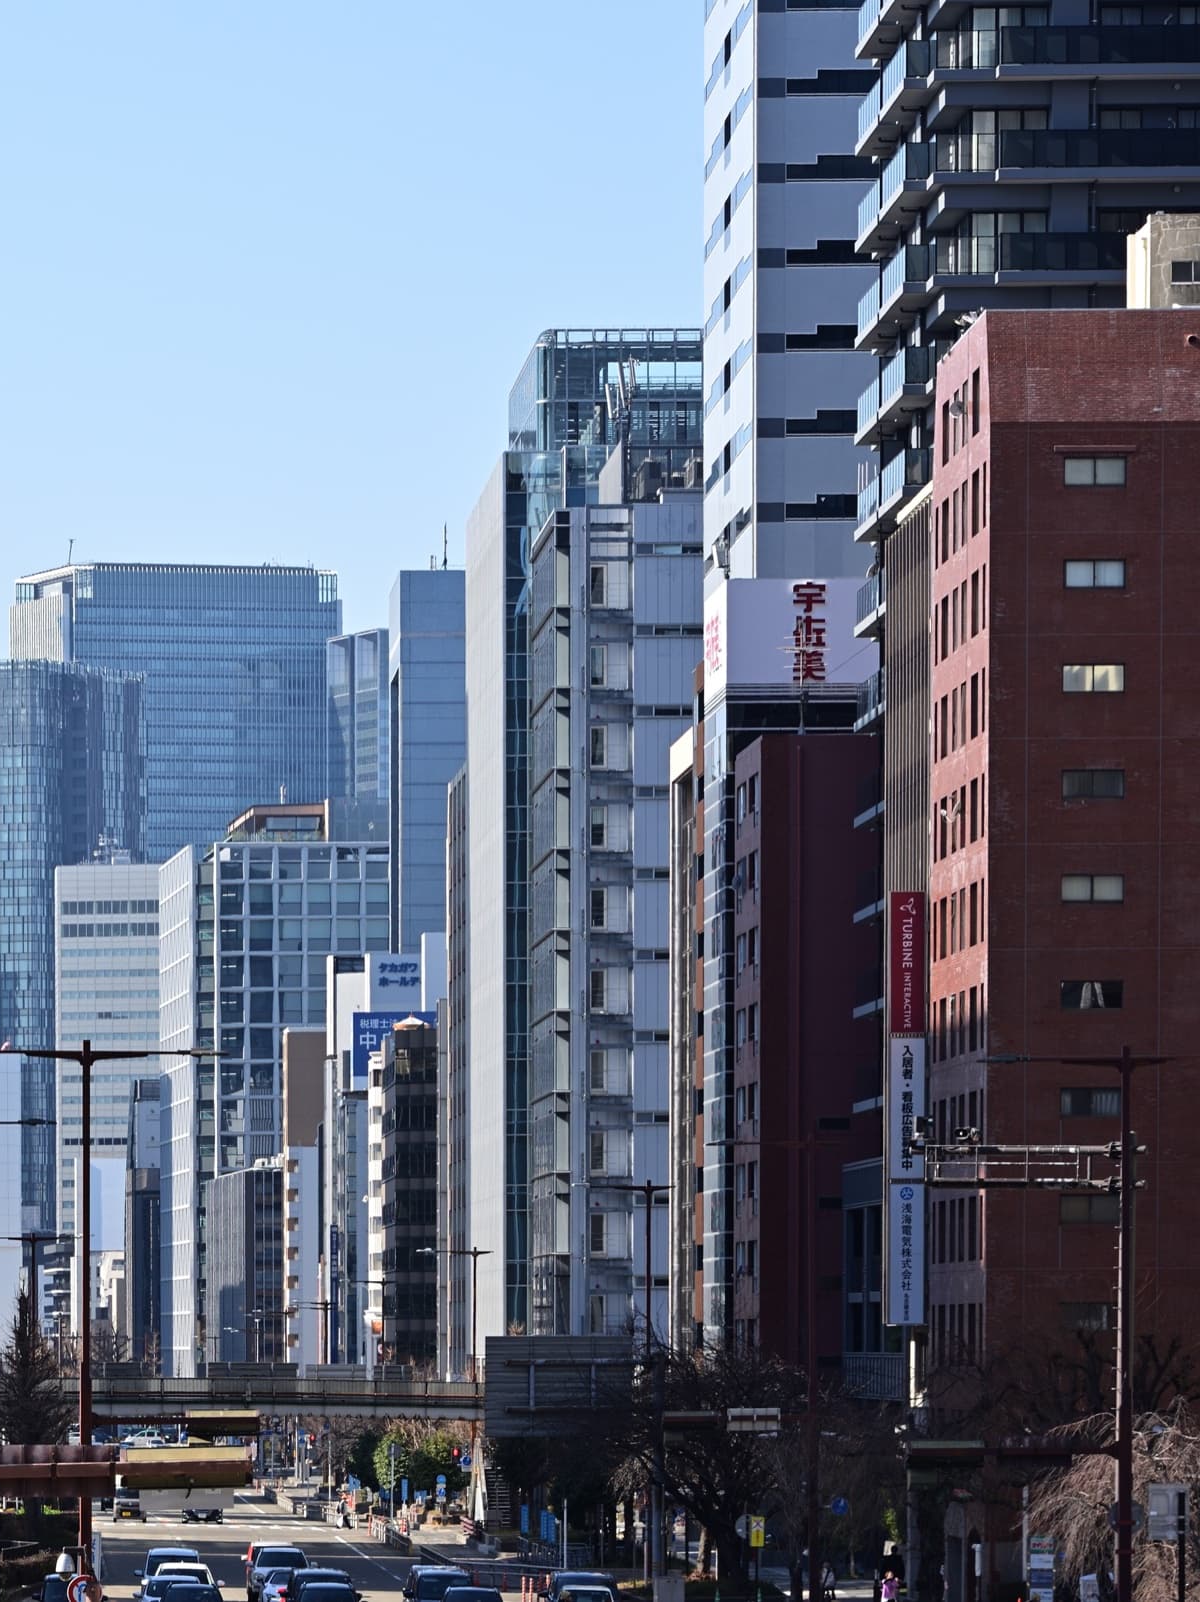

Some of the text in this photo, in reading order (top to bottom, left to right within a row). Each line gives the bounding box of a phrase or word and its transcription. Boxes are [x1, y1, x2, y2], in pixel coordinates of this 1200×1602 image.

[792, 581, 826, 681] 宇佐美
[902, 918, 913, 1029] TURBINE INTERACTIVE
[901, 1202, 913, 1291] 浅海電気株式会社
